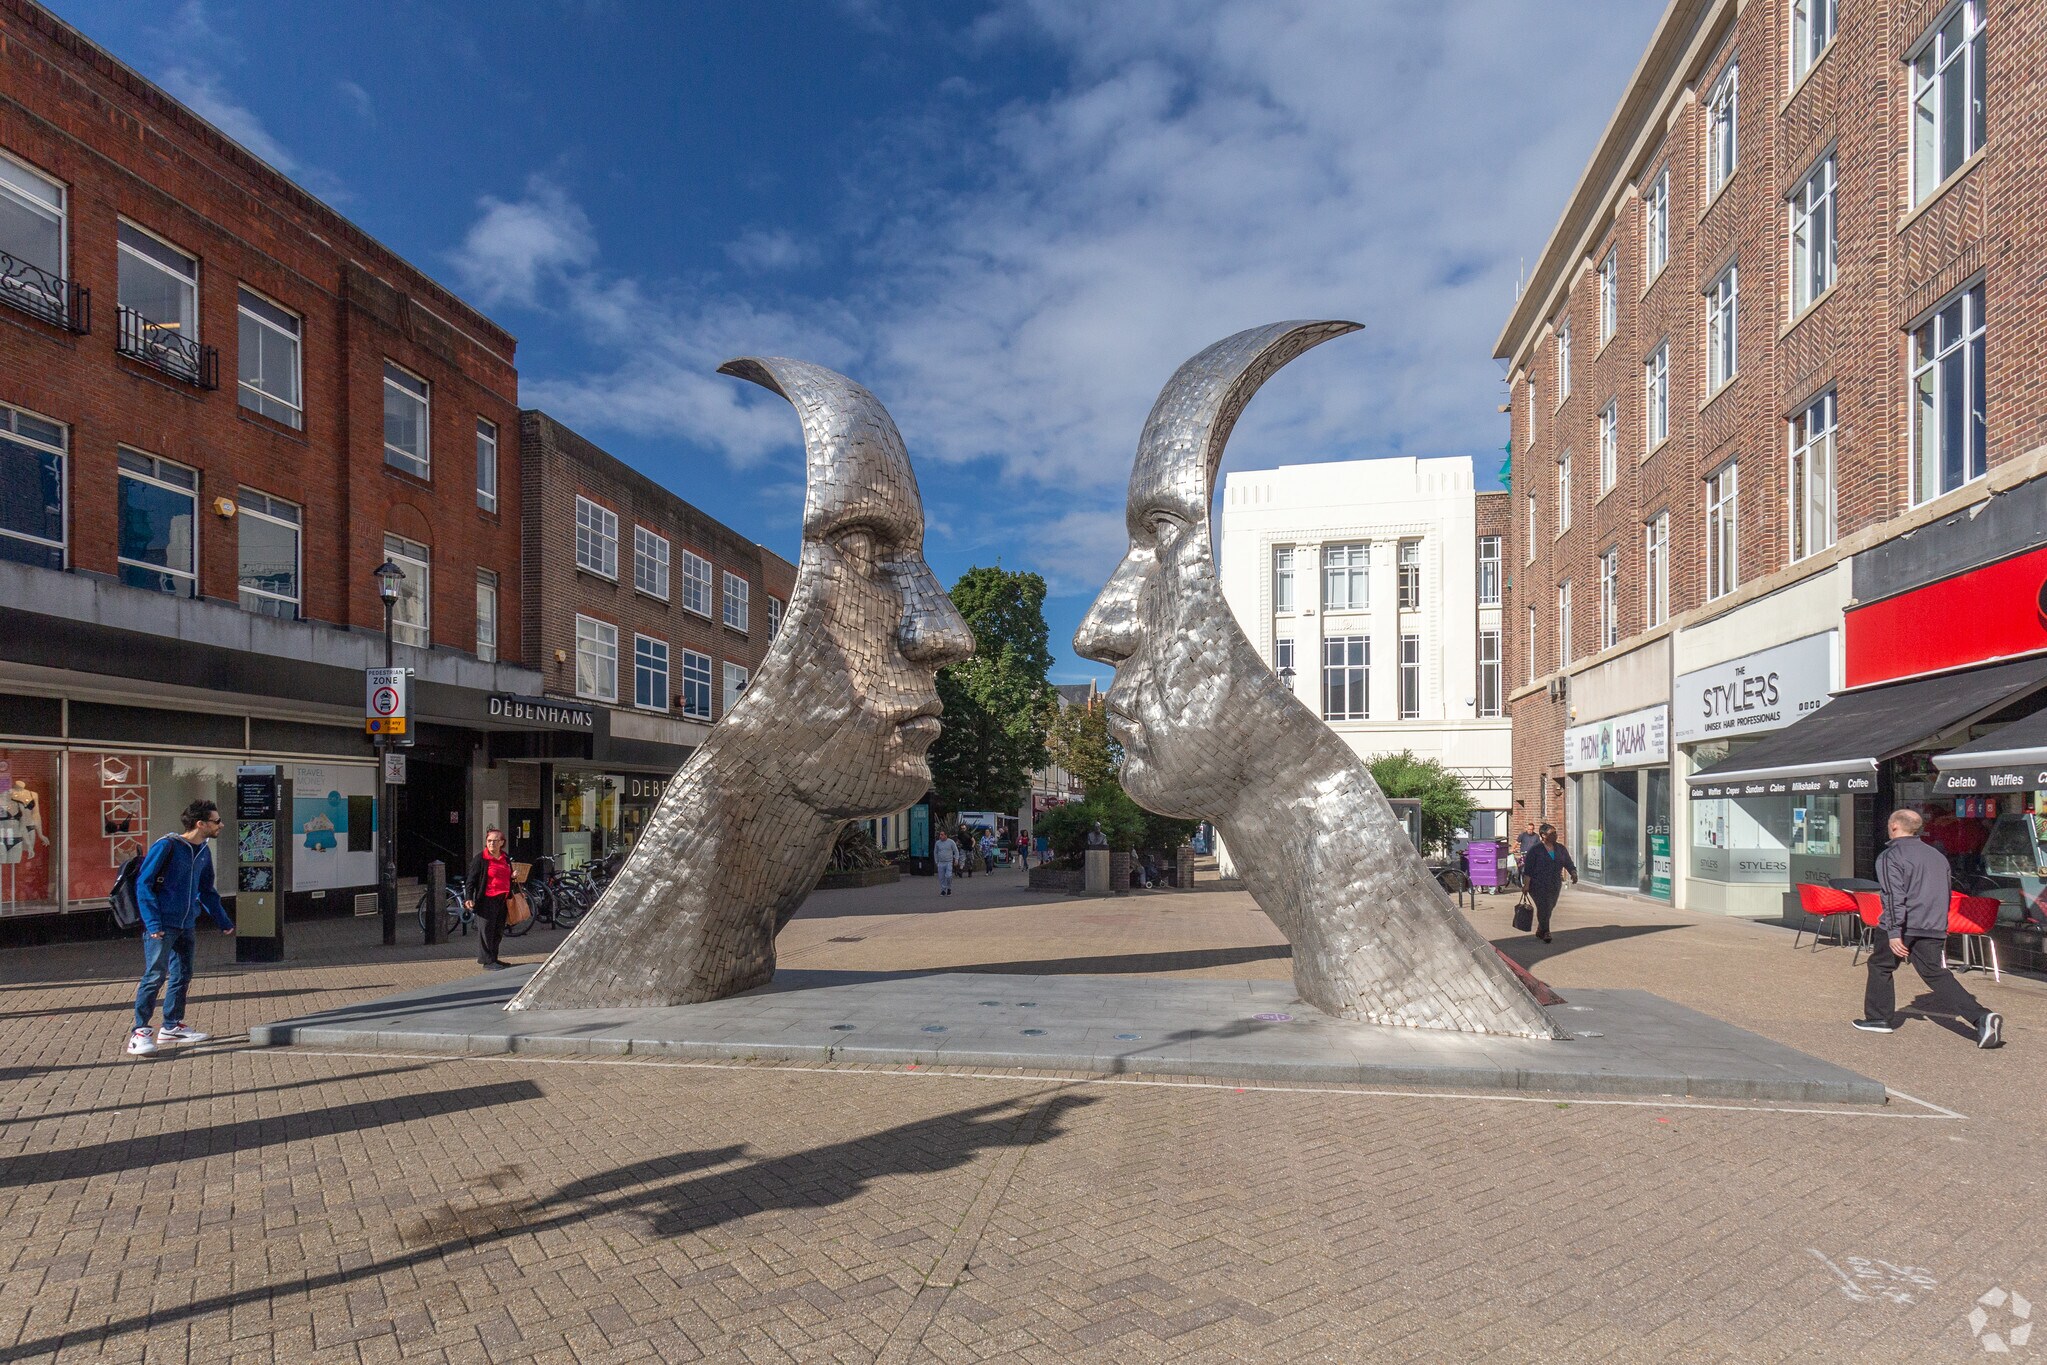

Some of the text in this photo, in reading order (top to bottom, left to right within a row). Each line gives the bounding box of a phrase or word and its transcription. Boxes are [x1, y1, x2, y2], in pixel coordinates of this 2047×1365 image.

[1735, 666, 1746, 676] THE
[373, 676, 398, 685] ZONE
[1703, 672, 1780, 718] STYLERS
[489, 698, 593, 727] DEBENHAMS
[1704, 711, 1781, 732] UNISEX HAIR PROFESSIONALS
[1616, 722, 1646, 756] BAZAAR
[296, 767, 325, 777] TRAVEL
[297, 776, 326, 786] MONEY
[1769, 783, 1786, 792] Cakes
[1791, 781, 1821, 791] Milkshakes
[1828, 780, 1839, 789] Tea
[1847, 778, 1869, 789] Coffee
[1947, 776, 1977, 788] Gelato
[1990, 774, 2024, 787] Waffles
[1654, 860, 1671, 873] TO LET
[1700, 859, 1718, 869] STYLERS
[1739, 861, 1787, 871] STYLERS
[1804, 870, 1831, 881] STYLERS
